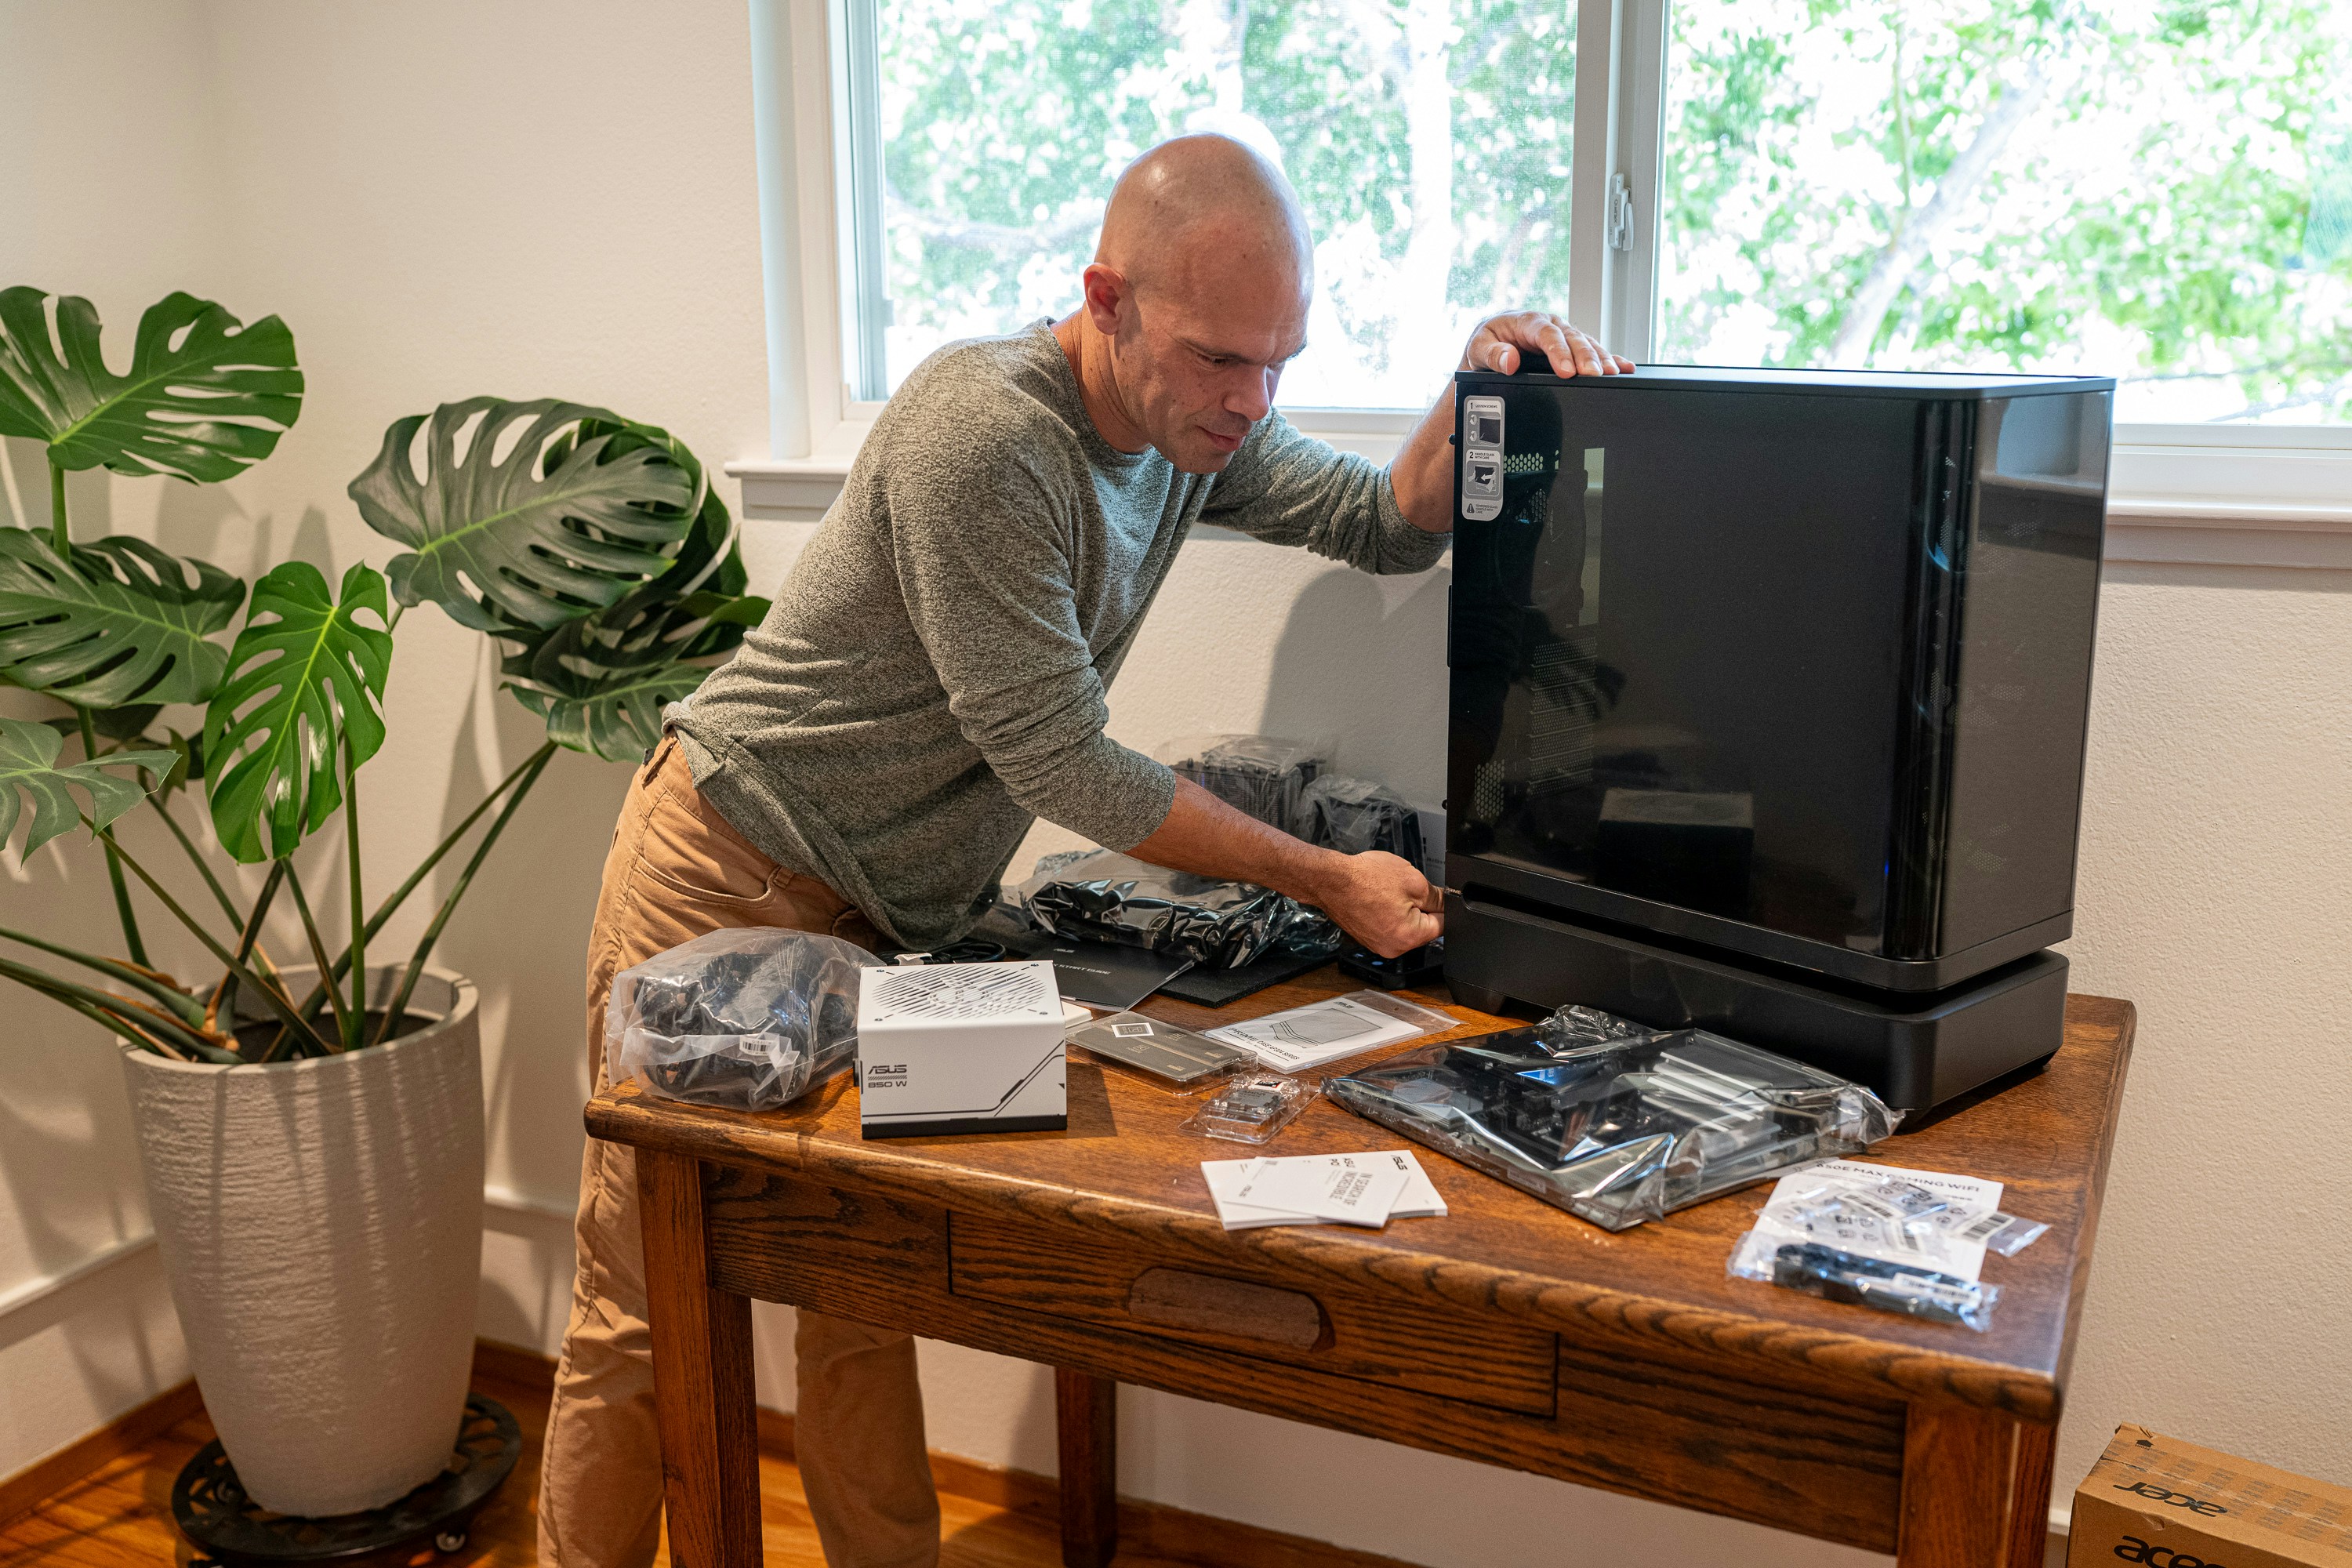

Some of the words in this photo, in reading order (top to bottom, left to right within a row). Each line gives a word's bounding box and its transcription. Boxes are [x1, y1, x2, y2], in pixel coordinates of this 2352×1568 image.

[1228, 1027, 1259, 1042] PRIME
[868, 1065, 907, 1075] ASUS
[1391, 1155, 1408, 1171] ASUS
[1853, 1167, 1882, 1177] MAX
[2113, 1482, 2228, 1518] acer
[2114, 1535, 2227, 1568] ace
